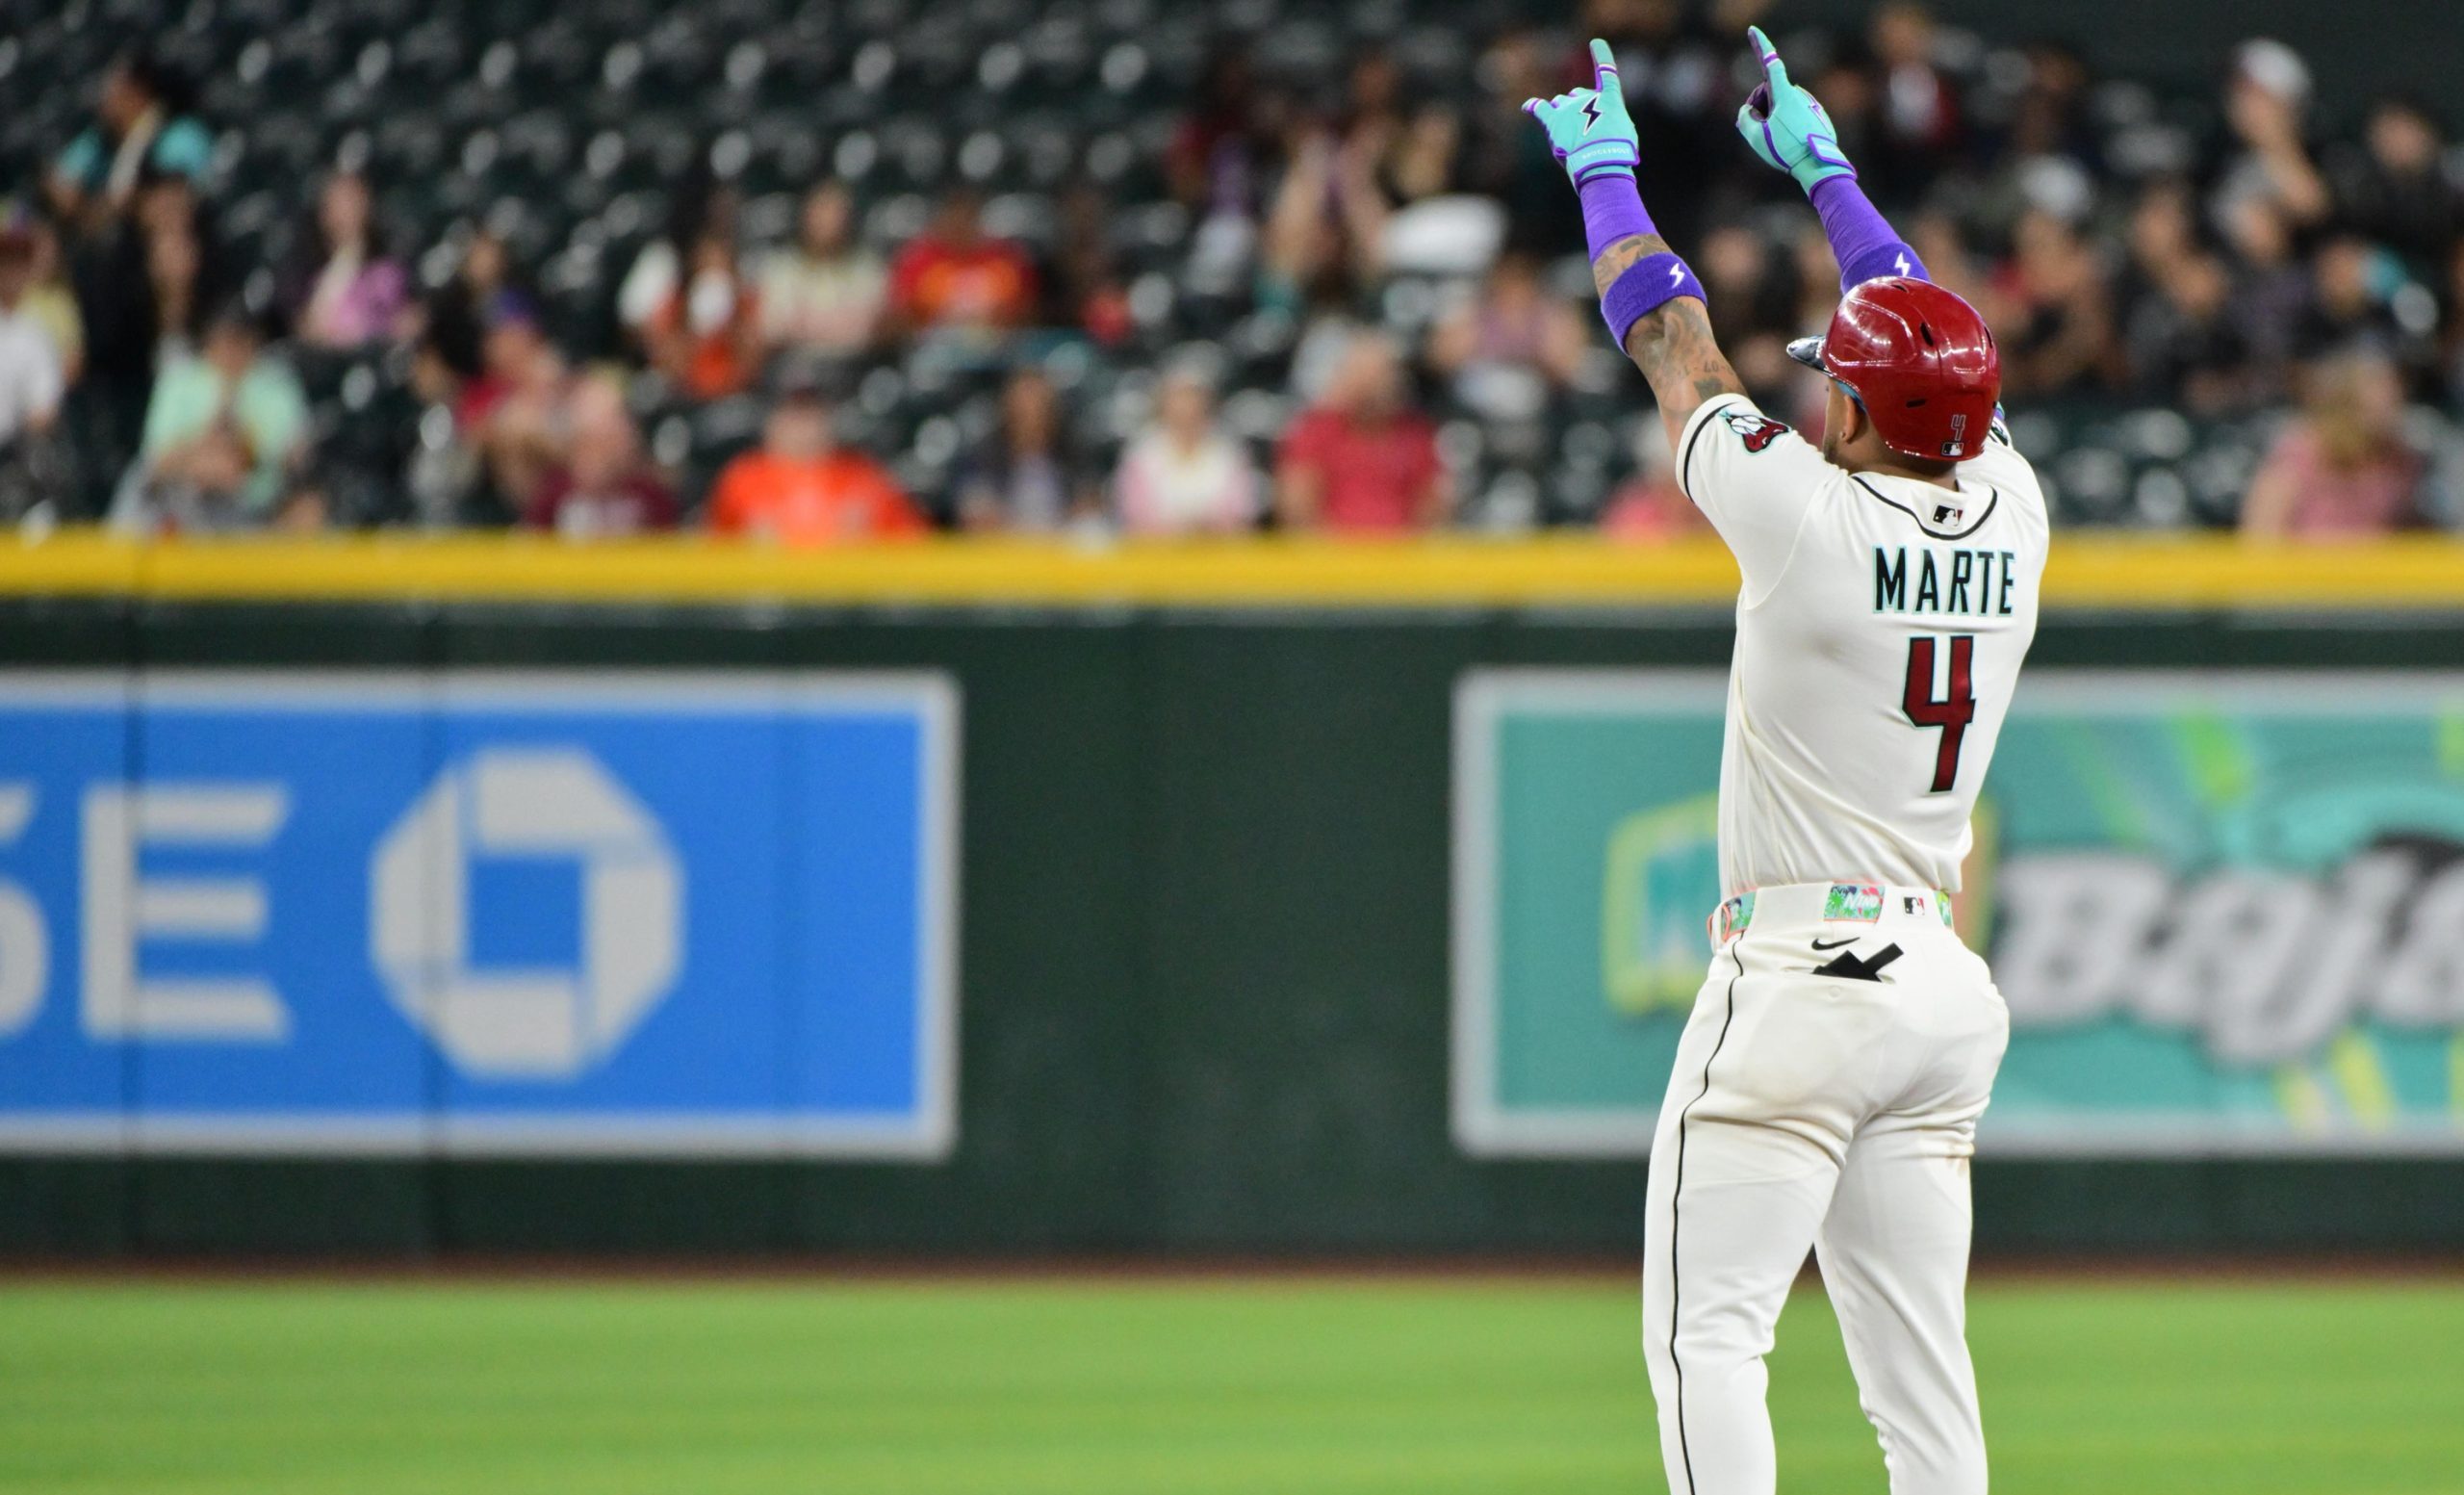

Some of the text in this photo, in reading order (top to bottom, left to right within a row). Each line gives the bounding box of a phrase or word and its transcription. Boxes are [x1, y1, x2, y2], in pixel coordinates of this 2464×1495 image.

[1950, 413, 1967, 441] 4
[1873, 545, 2016, 616] MARTE
[1901, 633, 1976, 794] 4
[0, 780, 293, 1045] E
